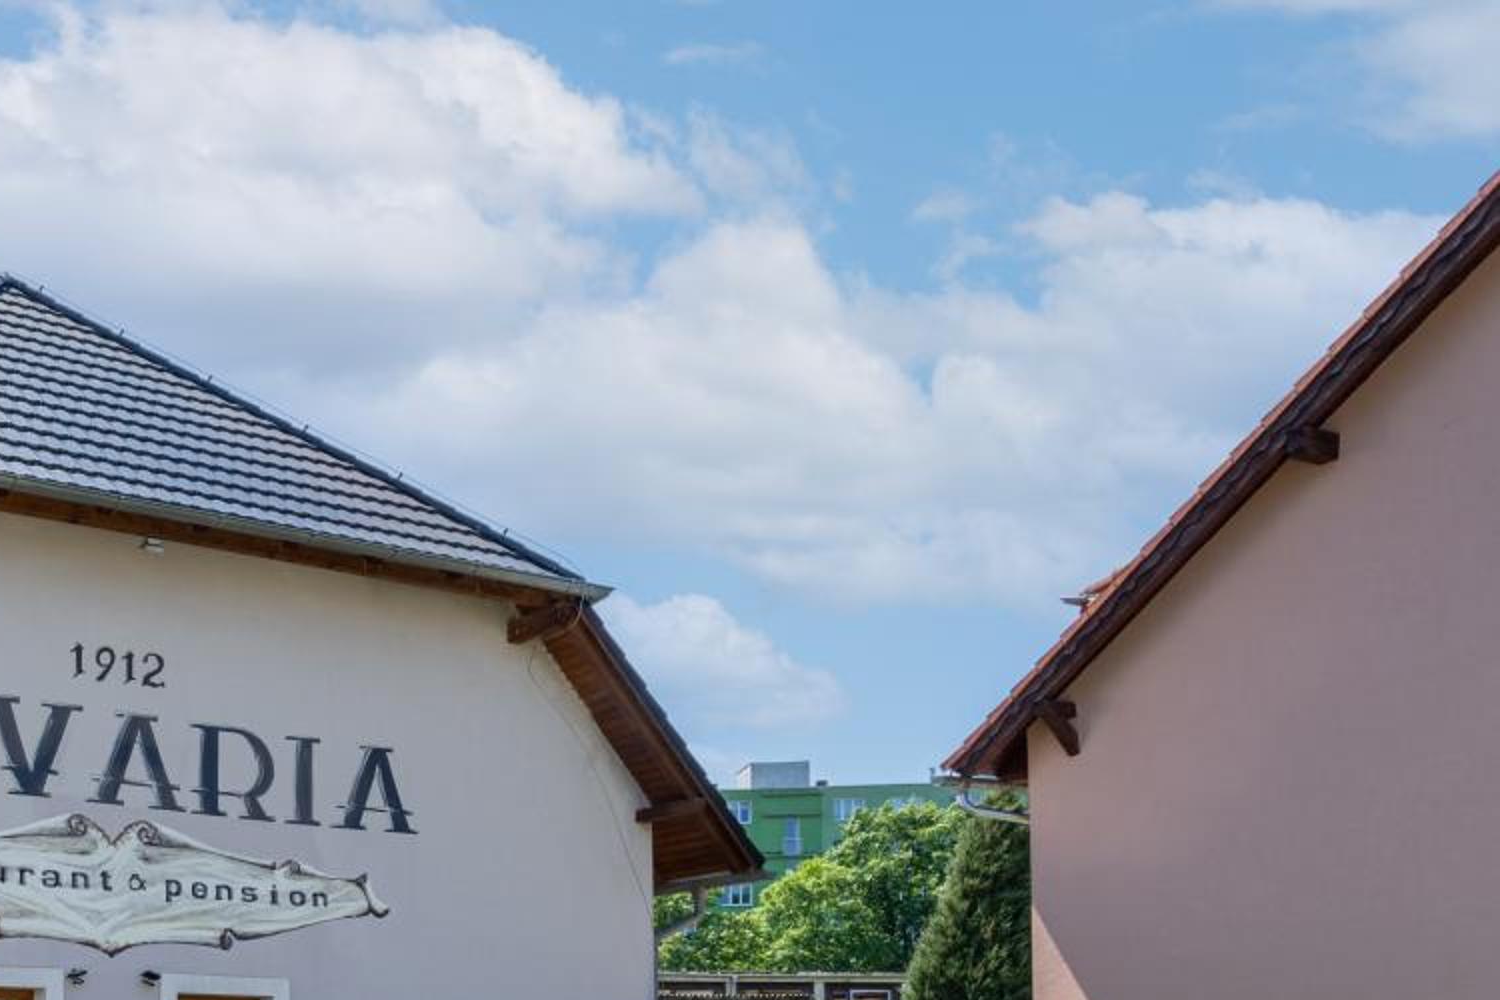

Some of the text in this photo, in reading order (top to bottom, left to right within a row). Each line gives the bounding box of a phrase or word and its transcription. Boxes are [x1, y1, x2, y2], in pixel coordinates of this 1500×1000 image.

[70, 643, 166, 688] 1912
[128, 873, 147, 892] &
[164, 876, 329, 908] pension
